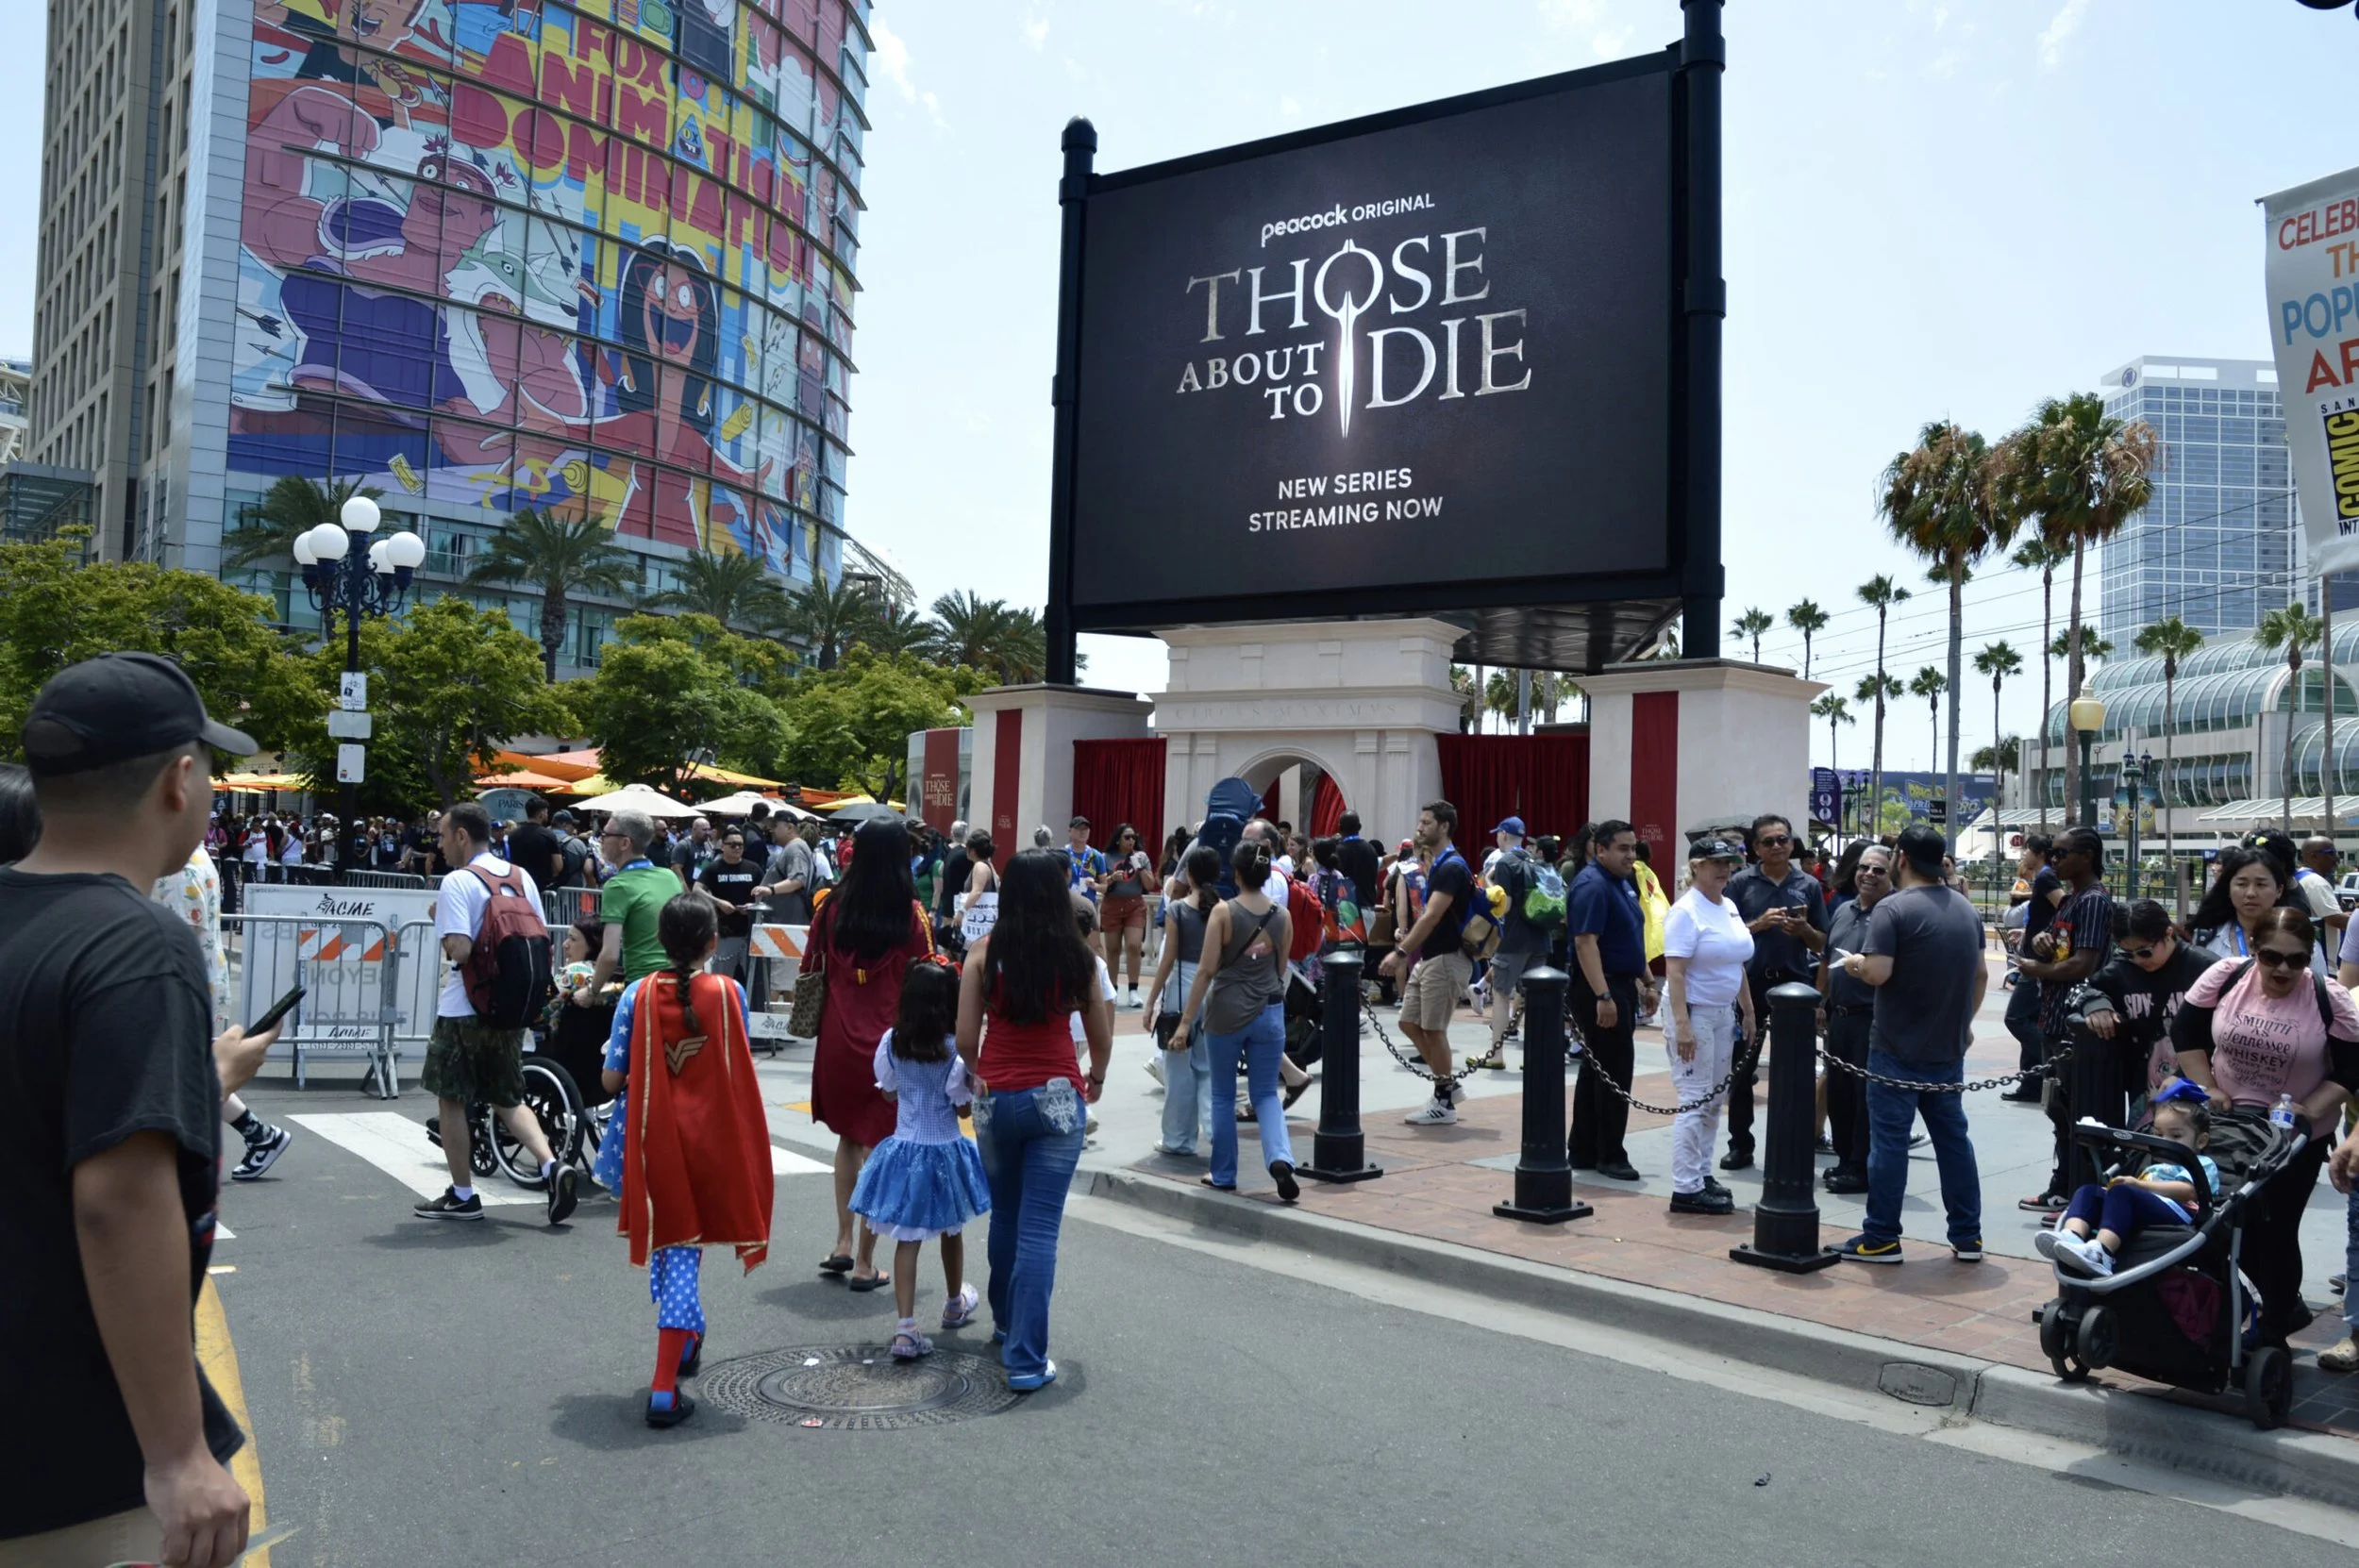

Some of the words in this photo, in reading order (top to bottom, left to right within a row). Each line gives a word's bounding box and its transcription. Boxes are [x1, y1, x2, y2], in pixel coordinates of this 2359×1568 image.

[577, 18, 667, 97] FOX
[479, 32, 804, 227] ANIMATION
[451, 82, 814, 293] DOMINATION
[1261, 204, 1347, 247] peacock
[1351, 193, 1435, 222] ORIGINAL
[2279, 196, 2359, 250] CELEB
[1185, 226, 1491, 343] THOSE
[1176, 342, 1325, 393] ABOUT
[1365, 309, 1532, 409] DIE
[1263, 382, 1323, 420] TO
[2320, 396, 2355, 413] SAN
[1278, 475, 1328, 499] NEW
[1334, 467, 1413, 494] SERIES
[1248, 503, 1379, 532] STREAMING
[1386, 496, 1444, 520] NOW
[324, 900, 376, 916] ACME
[2223, 1023, 2291, 1055] Tennessee
[2235, 1014, 2293, 1036] SMOOTH
[2251, 1026, 2269, 1037] AS
[2221, 1044, 2287, 1068] WHISKEY
